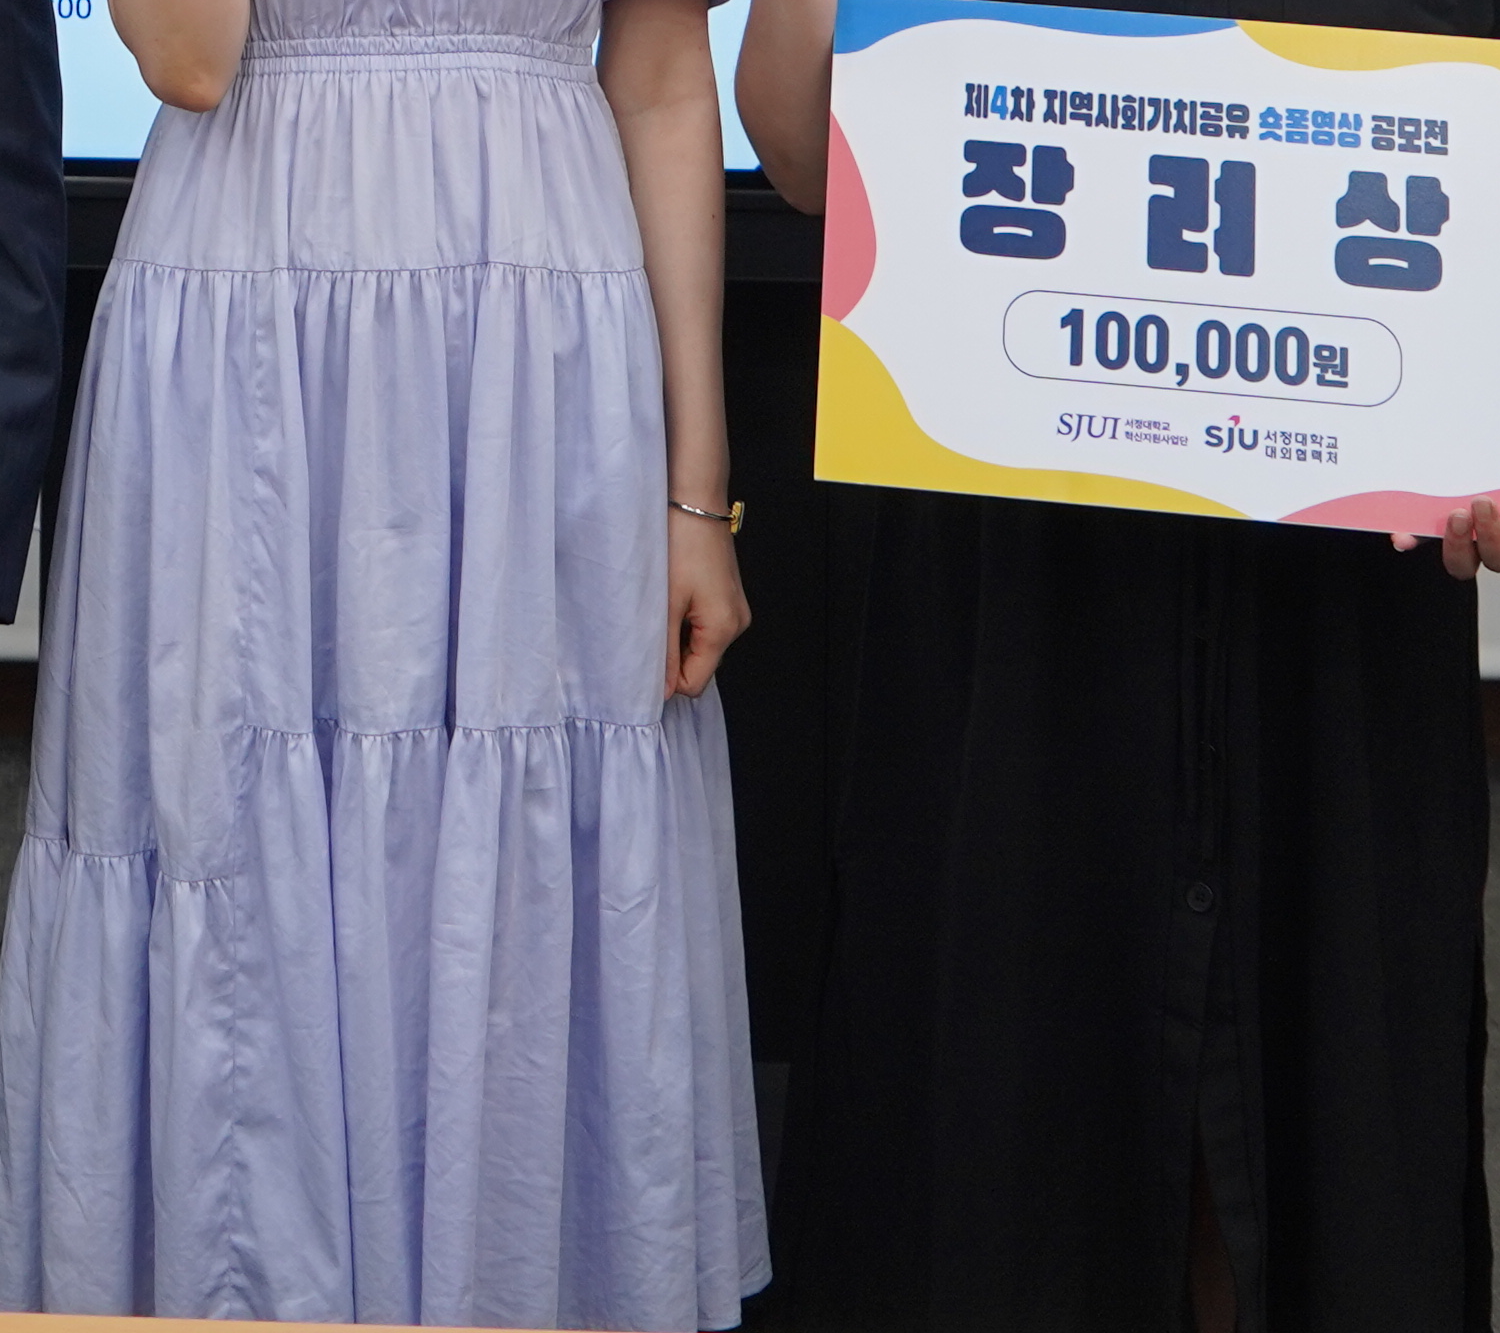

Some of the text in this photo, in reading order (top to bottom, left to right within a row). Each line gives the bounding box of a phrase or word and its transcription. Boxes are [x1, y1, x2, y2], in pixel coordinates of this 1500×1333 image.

[964, 82, 1449, 156] 제4차 지역사회가치공유 숏폼영상 공모전
[1058, 306, 1351, 391] 100,000원
[1056, 412, 1121, 443] SJUI
[1264, 430, 1339, 449] 서정대학교
[1264, 446, 1339, 466] 대외협력처
